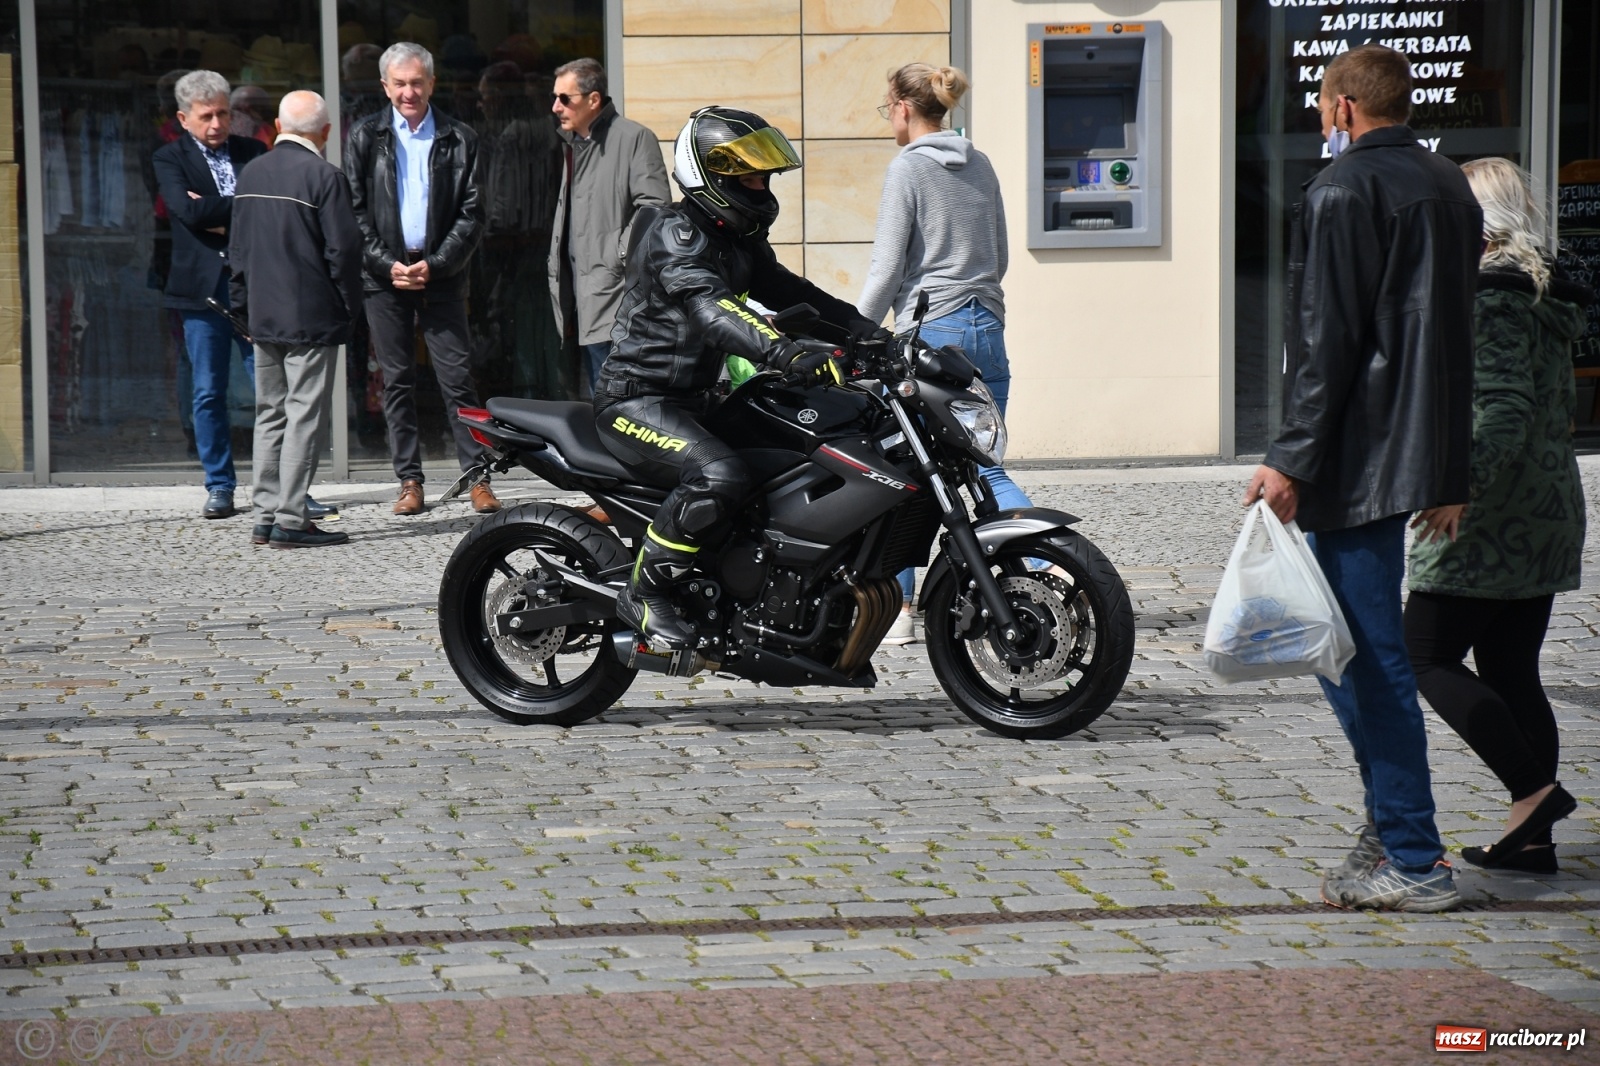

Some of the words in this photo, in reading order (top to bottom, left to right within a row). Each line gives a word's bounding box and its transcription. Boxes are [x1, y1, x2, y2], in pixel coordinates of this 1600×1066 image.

[1320, 10, 1444, 32] ZAPIEKANKI
[1293, 38, 1350, 57] KAWA
[1411, 87, 1457, 105] OWE
[716, 298, 780, 340] SHIMA
[611, 416, 688, 452] SHIMA
